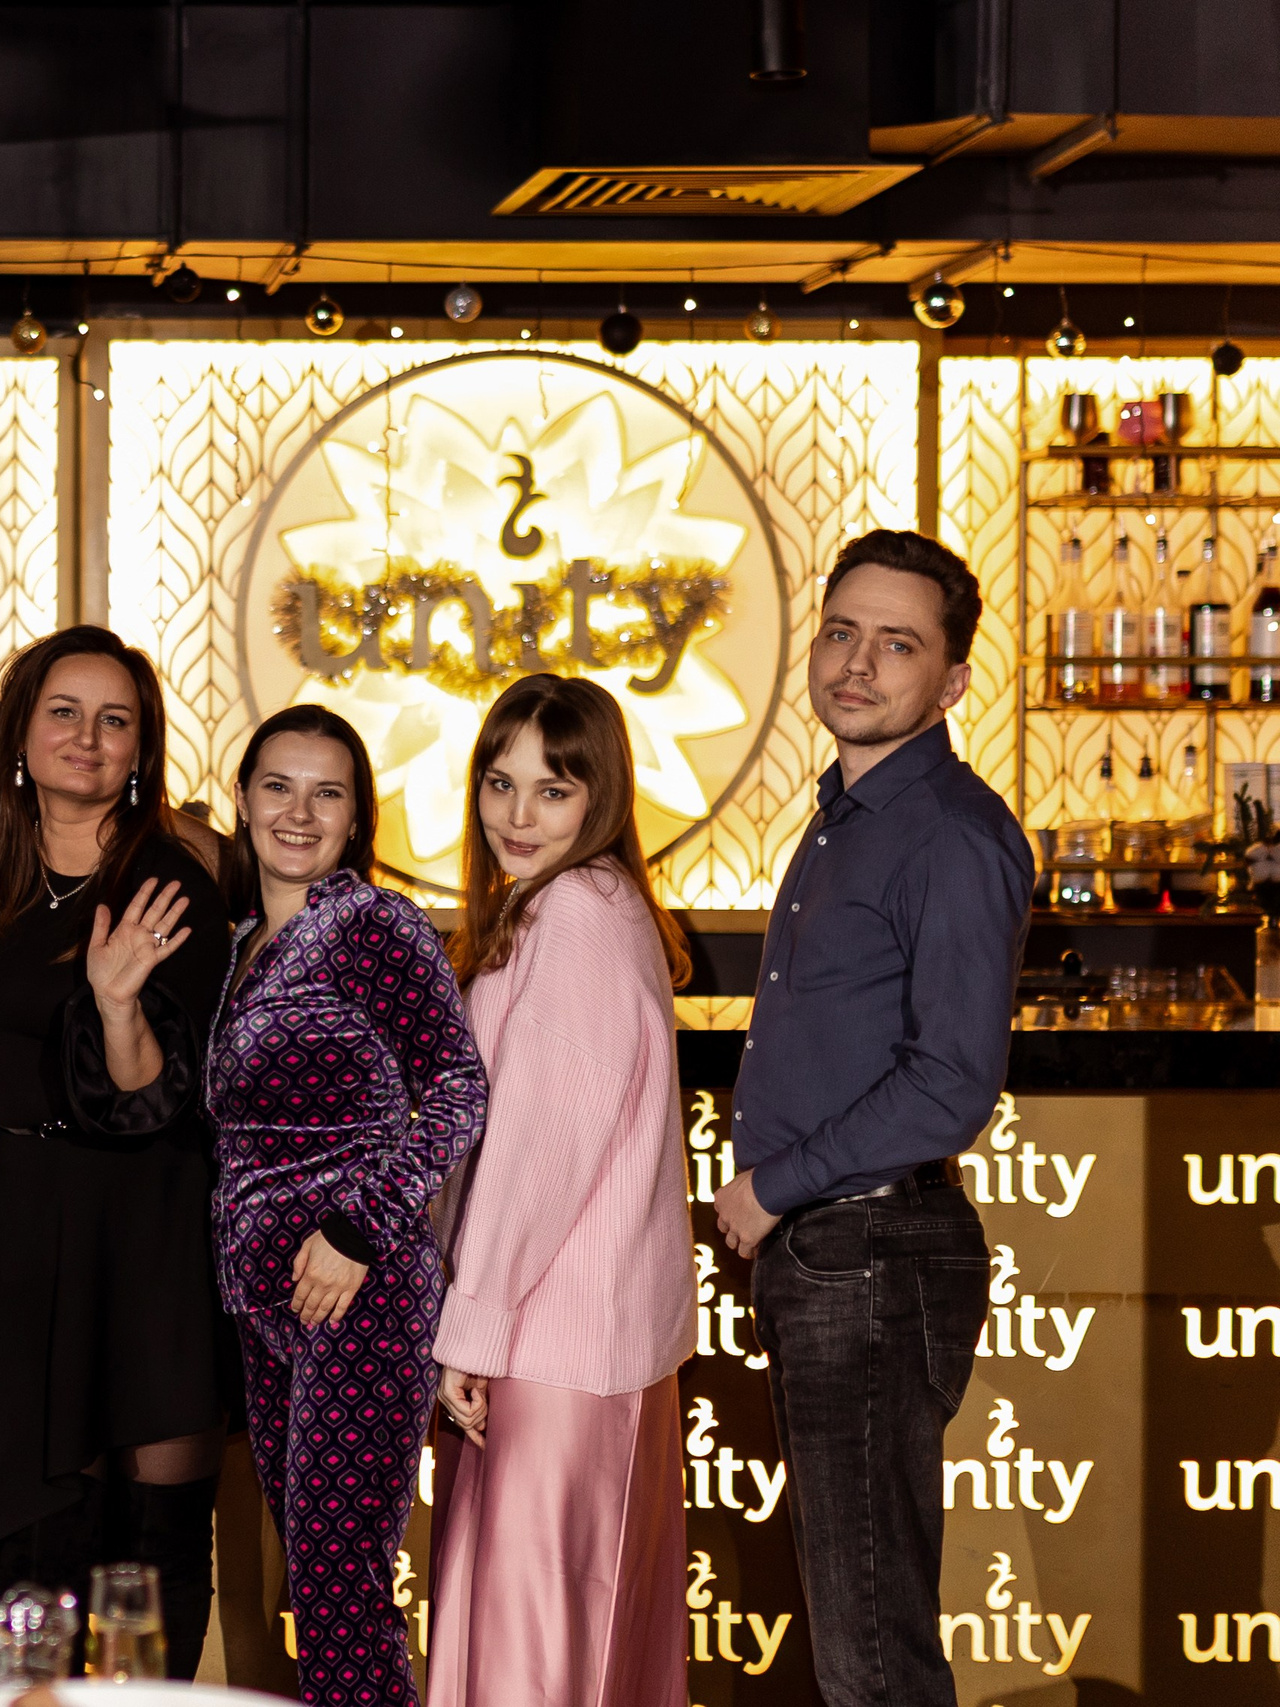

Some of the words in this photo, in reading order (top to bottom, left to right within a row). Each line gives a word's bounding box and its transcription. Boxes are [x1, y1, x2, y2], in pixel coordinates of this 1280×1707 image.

[289, 454, 719, 695] unity
[958, 1091, 1097, 1218] nity
[975, 1244, 1096, 1371] ity
[683, 1397, 787, 1523] ity
[942, 1398, 1094, 1524] nity
[686, 1551, 792, 1675] ity
[939, 1551, 1092, 1676] nity
